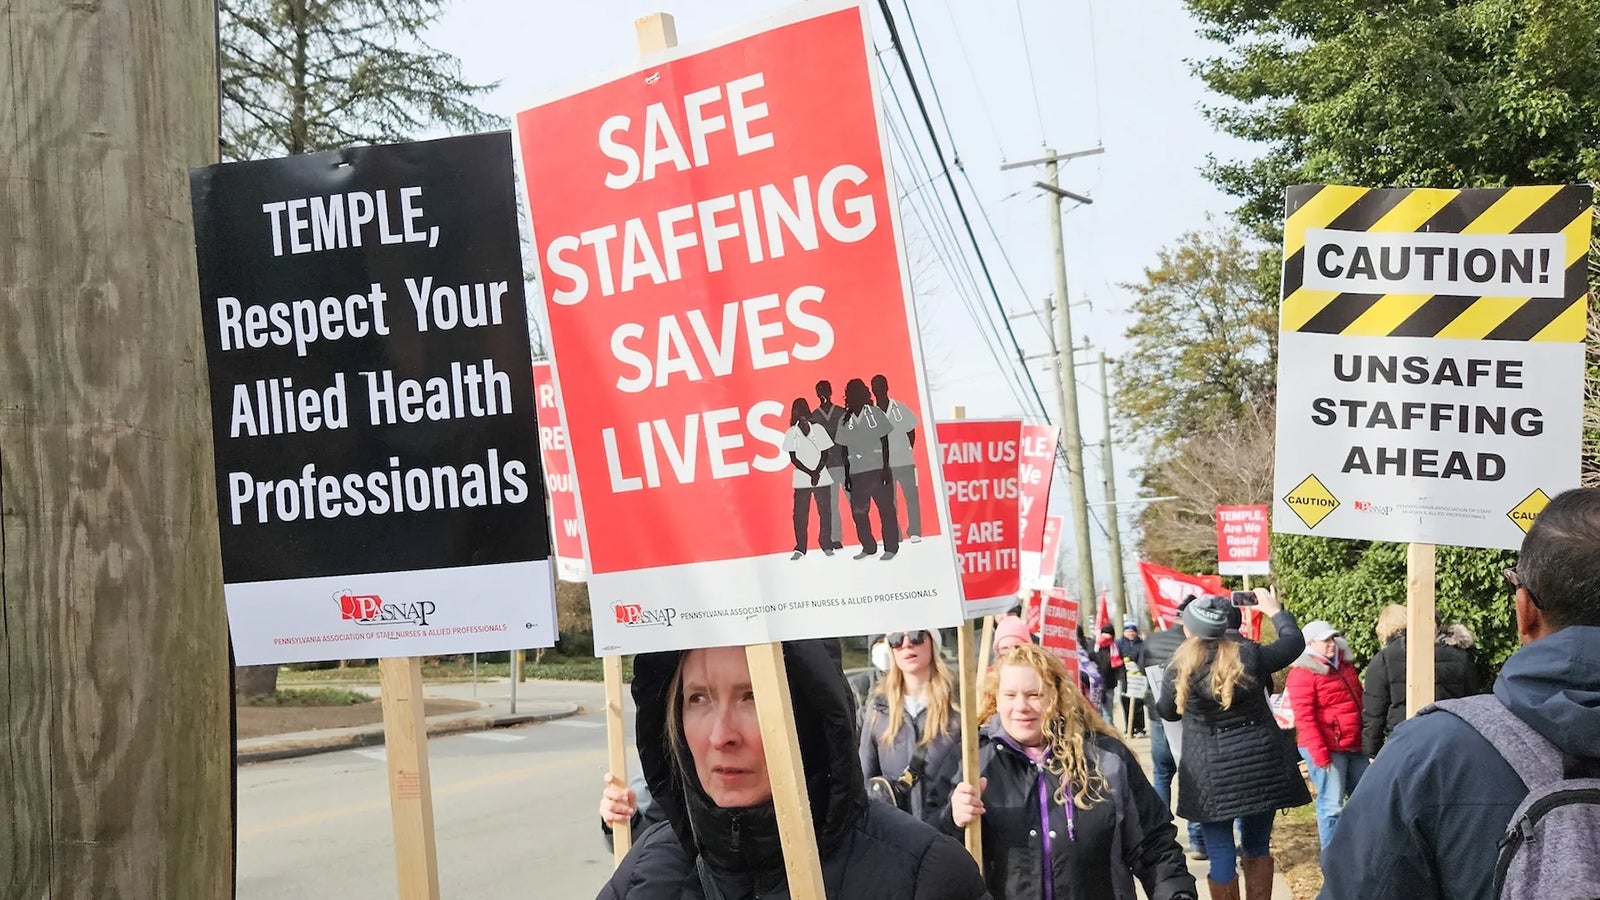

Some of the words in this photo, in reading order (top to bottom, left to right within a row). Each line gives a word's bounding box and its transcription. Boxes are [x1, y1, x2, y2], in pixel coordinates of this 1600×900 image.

[598, 71, 775, 190] SAFE
[262, 186, 440, 257] TEMPLE,
[545, 164, 878, 306] STAFFING
[1316, 243, 1550, 284] CAUTION!
[217, 283, 390, 357] Respect
[404, 276, 508, 332] Your
[610, 285, 835, 393] SAVES
[1333, 354, 1523, 389] UNSAFE
[230, 372, 349, 438] Allied
[367, 359, 513, 426] Health
[1311, 397, 1544, 437] STAFFING
[601, 400, 791, 494] LIVES
[938, 442, 982, 465] TAIN
[988, 440, 1016, 463] US
[1341, 446, 1507, 482] AHEAD
[228, 448, 529, 526] Professionals
[944, 479, 989, 502] PECT
[993, 478, 1018, 499] US
[1288, 496, 1335, 507] CAUTION
[1223, 523, 1242, 534] Are
[1243, 522, 1261, 533] We
[1512, 511, 1541, 520] CAU
[967, 521, 1004, 544] ARE
[1226, 535, 1259, 547] Really
[957, 551, 990, 574] RTH
[995, 548, 1017, 570] IT!
[1229, 547, 1258, 558] ONE?
[357, 596, 436, 626] PASNAP
[625, 605, 677, 627] PASNAP
[680, 609, 729, 621] PENNSYLVANIA
[730, 605, 776, 617] ASSOCIATION
[777, 602, 788, 611] OF
[789, 600, 811, 610] STAFF
[811, 597, 840, 608] NURSES
[841, 597, 846, 605] &
[848, 594, 873, 605] ALLIED
[874, 589, 938, 603] PROFESSIONALS
[273, 636, 321, 646] PENNSYLVANIA
[322, 633, 365, 643] ASSOCIATION
[366, 632, 374, 640] OF
[376, 631, 394, 639] STAFF
[395, 629, 420, 638] NURSES
[422, 628, 427, 636] &
[428, 627, 451, 636] ALLIED
[452, 623, 508, 634] PROFESSIONALS
